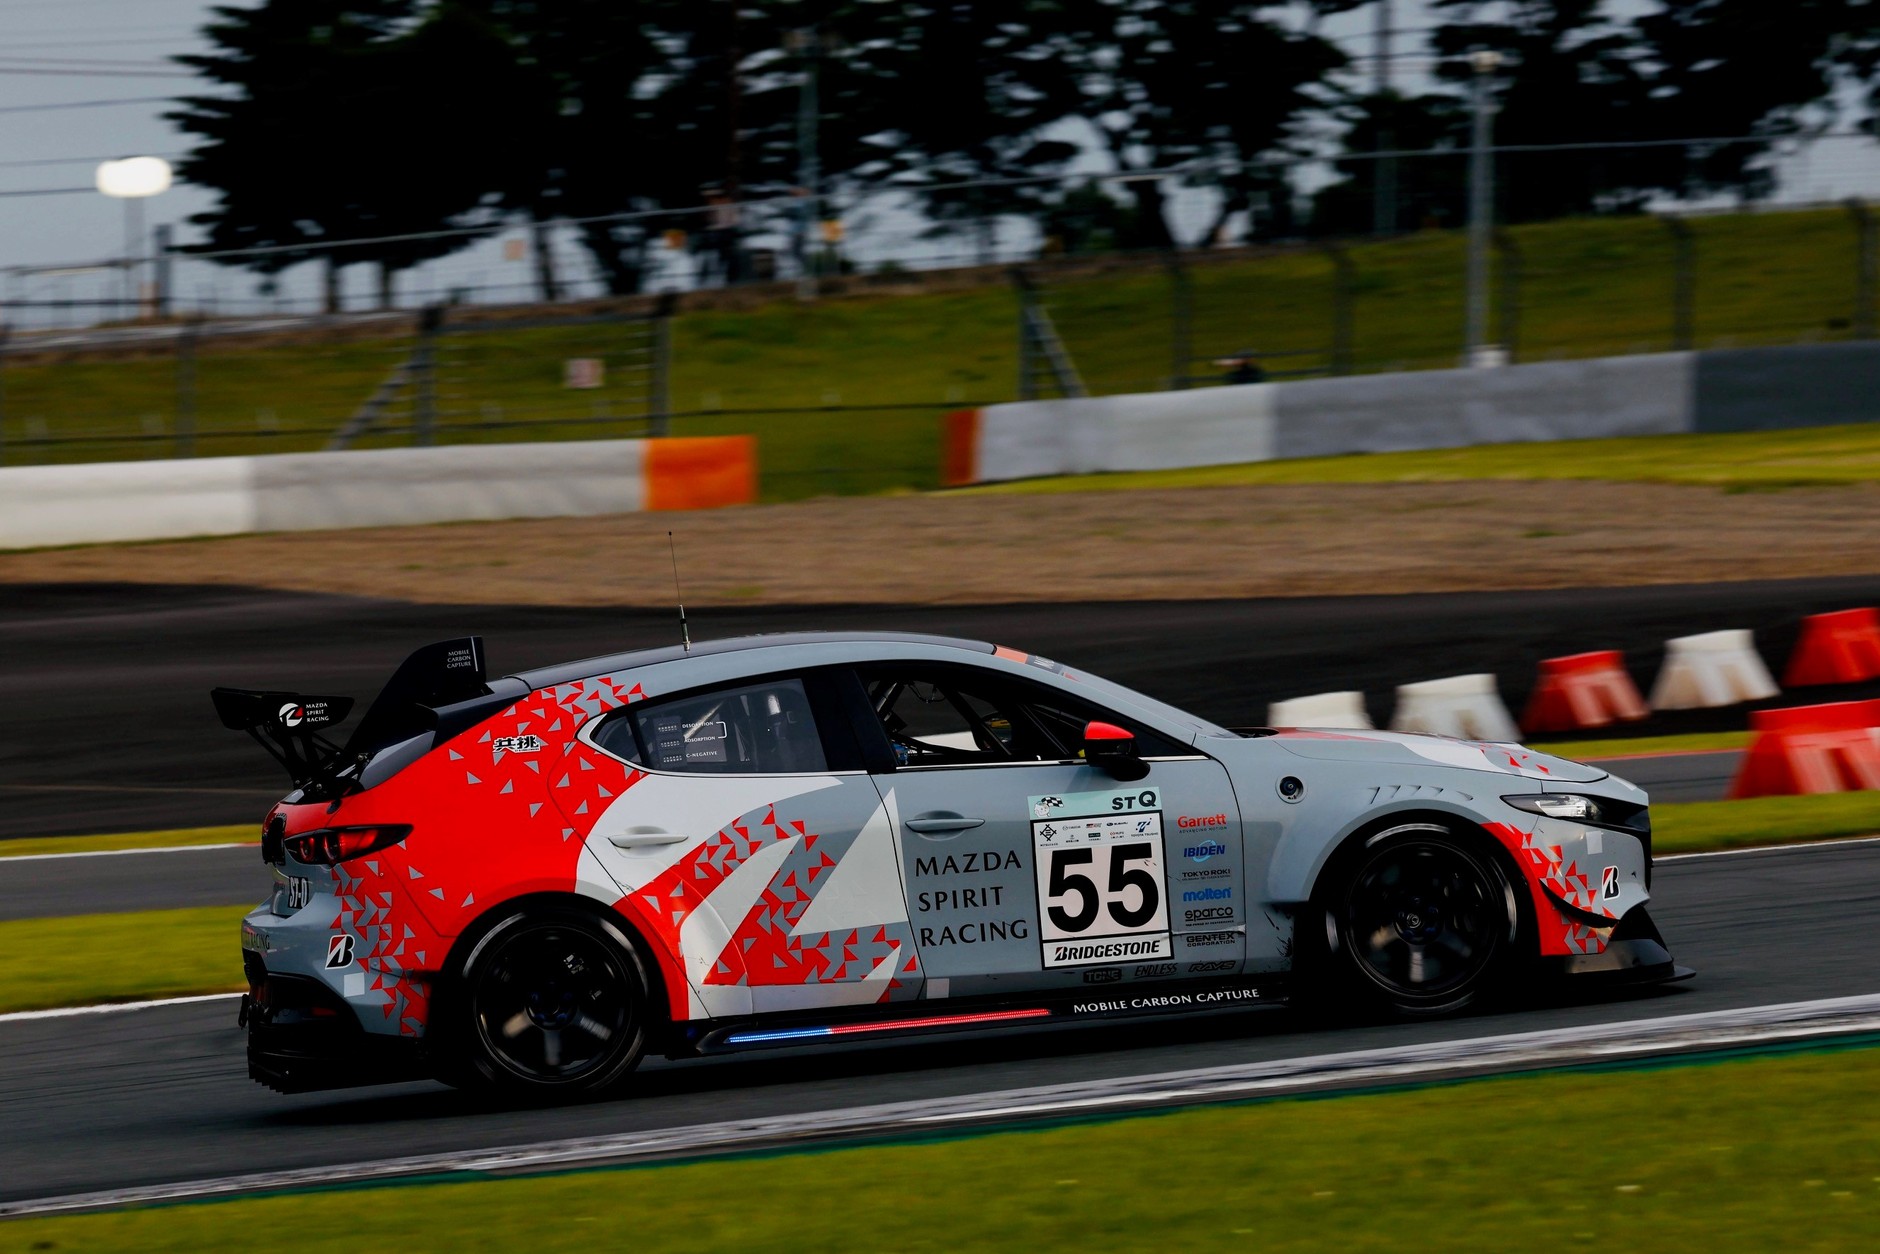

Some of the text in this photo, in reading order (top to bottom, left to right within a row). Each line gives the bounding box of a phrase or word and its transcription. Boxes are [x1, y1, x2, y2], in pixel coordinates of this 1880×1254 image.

[446, 661, 471, 669] CAPTURE
[447, 655, 471, 663] CARBON
[306, 715, 330, 723] RACING
[682, 721, 714, 729] DESOTION
[1177, 813, 1227, 829] Garrett
[1183, 844, 1226, 858] IBIDEN
[915, 849, 1023, 877] MAZDA
[1182, 869, 1210, 878] TOKYO
[1210, 868, 1231, 876] ROKI
[1047, 842, 1160, 933] 55
[1182, 887, 1232, 901] molten
[918, 886, 1004, 912] SPIRIT
[1184, 906, 1234, 921] sparco
[919, 919, 1029, 948] RACING
[1186, 931, 1235, 943] GENTEX
[1054, 940, 1161, 962] BRIDGESTONE
[1186, 940, 1236, 948] CORPORATION
[1134, 962, 1179, 979] ENDLESS
[1188, 960, 1236, 973] RAYS
[1073, 988, 1260, 1014] MOBILE CARBON CAPTURE
